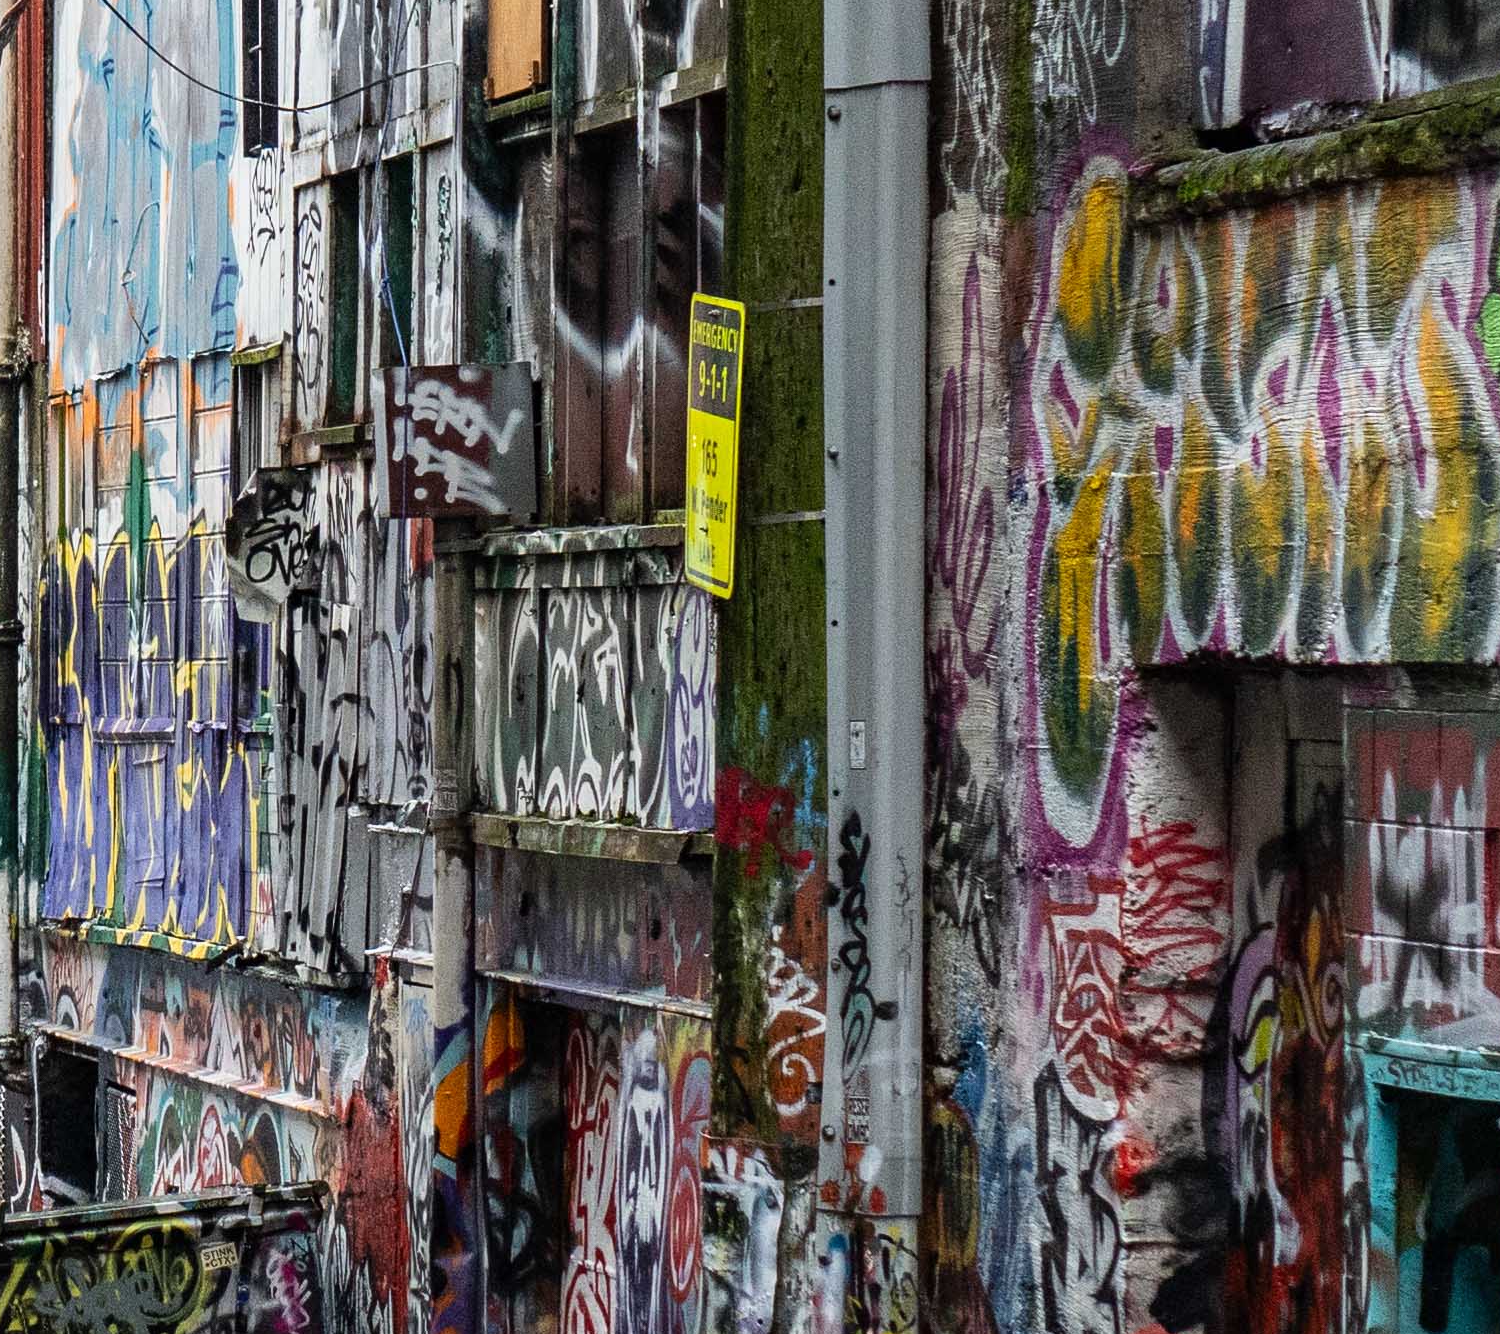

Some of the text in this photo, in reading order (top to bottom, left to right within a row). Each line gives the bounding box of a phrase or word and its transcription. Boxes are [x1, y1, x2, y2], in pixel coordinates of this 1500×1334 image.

[693, 319, 739, 353] EMERGENCY
[698, 359, 729, 403] 9-1-1
[701, 438, 718, 478] 165
[700, 488, 728, 524] Pender
[203, 1246, 234, 1261] STINK
